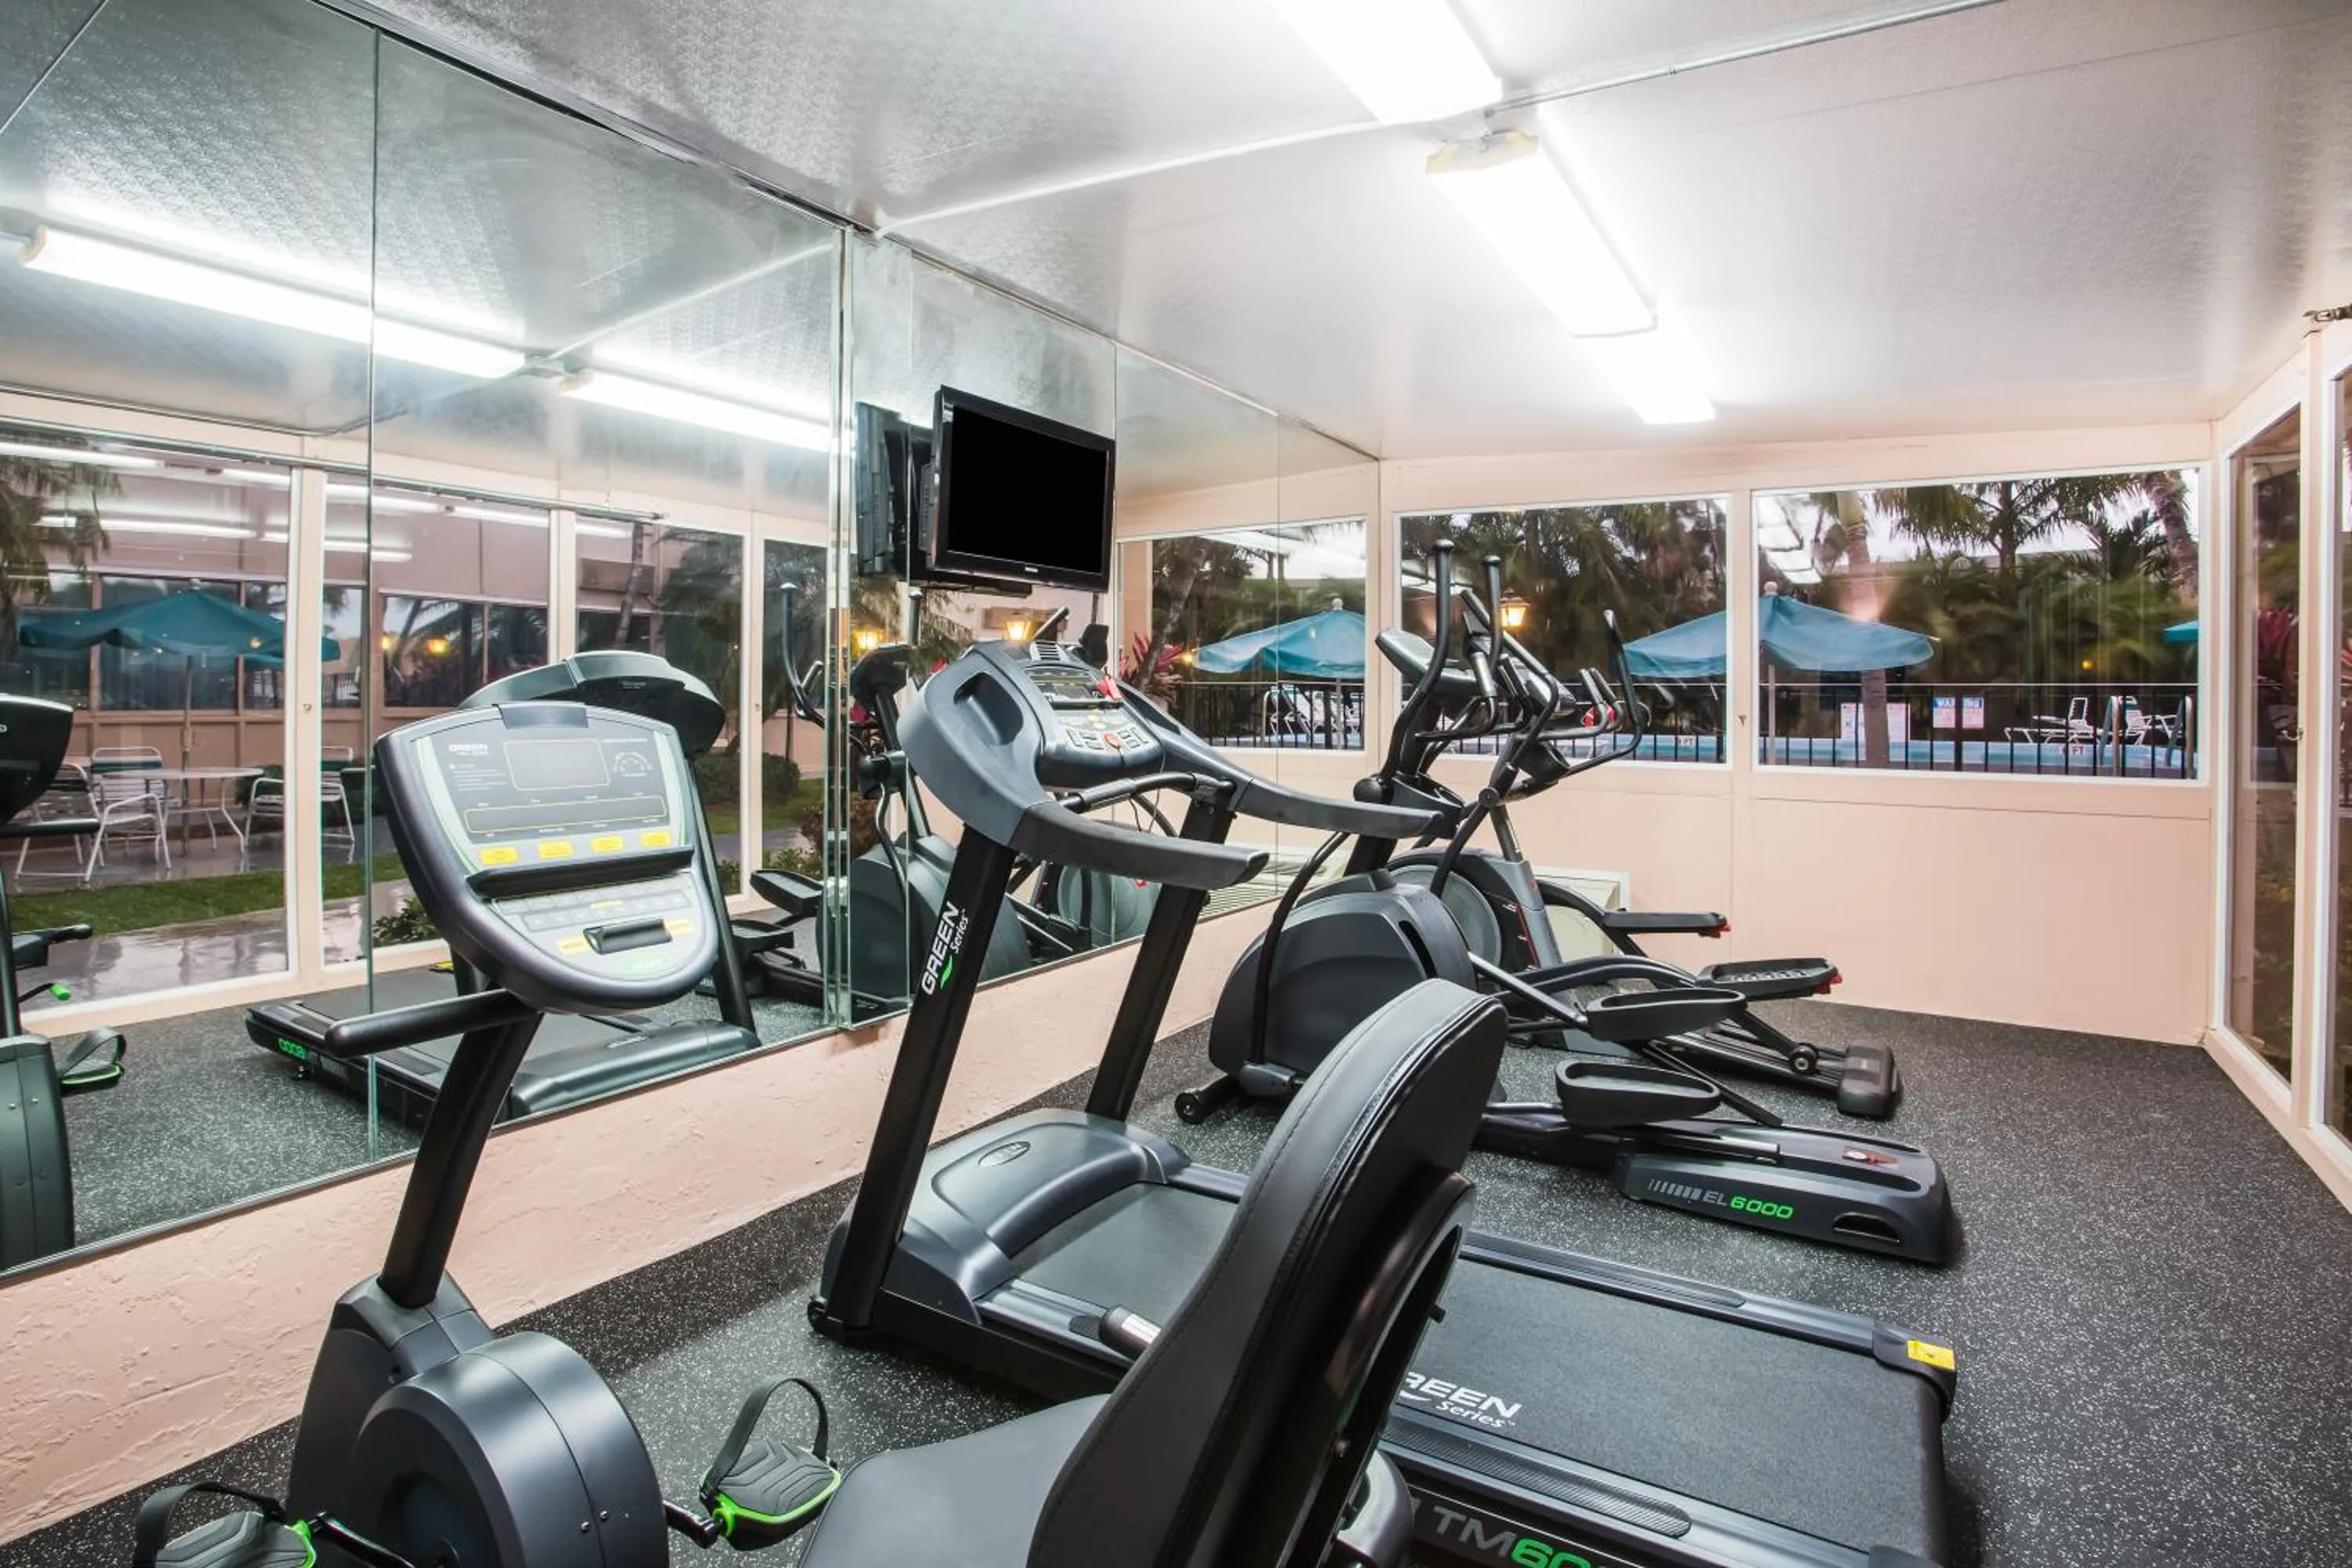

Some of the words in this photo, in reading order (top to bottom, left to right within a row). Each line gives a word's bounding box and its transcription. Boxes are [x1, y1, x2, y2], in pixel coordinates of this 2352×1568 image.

[921, 901, 959, 995] GREEN
[949, 916, 969, 954] Series
[1703, 1190, 1727, 1207] EL
[1730, 1196, 1794, 1219] 6000
[1405, 1371, 1522, 1418] REEN
[1436, 1401, 1505, 1428] Series
